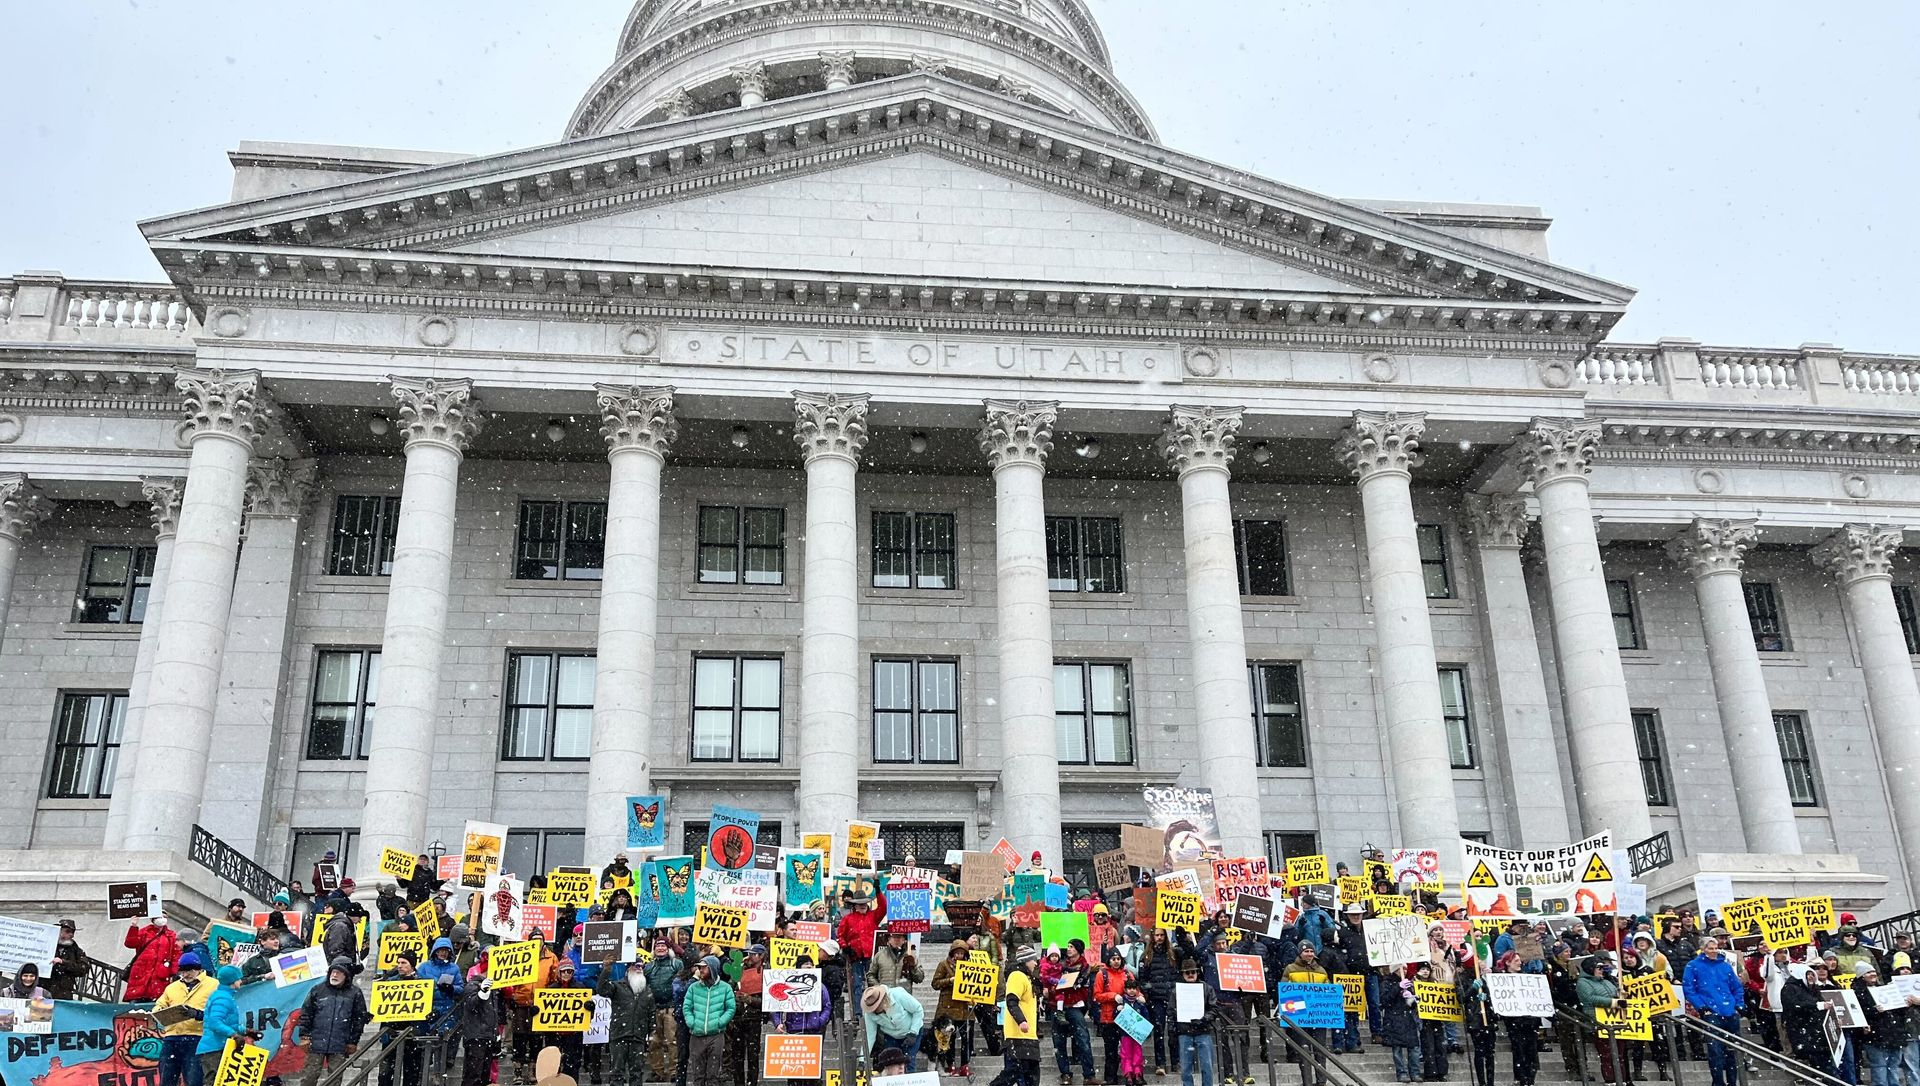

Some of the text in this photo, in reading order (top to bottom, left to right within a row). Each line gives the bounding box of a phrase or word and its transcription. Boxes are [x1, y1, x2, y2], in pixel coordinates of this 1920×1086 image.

[720, 336, 1126, 374] STATE OF UTAH
[714, 813, 758, 827] PEOPLE POWER
[386, 849, 414, 860] Protect
[1466, 836, 1609, 861] PROTECT OUR FUTURE
[388, 854, 411, 866] WILD
[466, 854, 497, 864] BREAK FREE
[384, 862, 410, 875] UTAH
[1097, 862, 1124, 873] FEDERAL
[1217, 861, 1266, 878] RISE UP
[1293, 863, 1321, 872] WILD
[1500, 858, 1576, 873] SAY NO TO
[727, 870, 742, 880] RISE
[919, 869, 935, 880] LET
[1099, 871, 1113, 880] KEEP
[1293, 871, 1323, 882] UTAH
[1504, 870, 1574, 886] URANIUM
[555, 882, 588, 891] WILD
[732, 887, 761, 896] KEEP
[552, 892, 588, 902] UTAH
[890, 891, 928, 902] PROTECT
[1160, 894, 1197, 904] Protect
[1342, 892, 1357, 900] UTAH
[1790, 898, 1828, 906] Protect
[416, 902, 432, 914] Protect
[700, 906, 747, 916] Protect
[1164, 900, 1194, 913] WILD
[1724, 899, 1764, 912] Protect
[419, 911, 432, 924] WILD
[1161, 912, 1194, 925] UTAH
[1730, 906, 1764, 920] WILD
[1762, 908, 1799, 920] Protect
[704, 914, 742, 927] WILD
[1732, 918, 1758, 931] UTA
[1767, 916, 1799, 930] WILD
[1805, 915, 1829, 926] TAH
[422, 922, 436, 938] UTAH
[699, 926, 742, 942] UTAH
[1770, 927, 1804, 943] UTAH
[388, 942, 422, 952] WILD
[492, 944, 535, 955] Protect
[384, 952, 423, 964] UTH
[497, 952, 531, 967] WILD
[493, 965, 532, 981] UTAH
[960, 964, 996, 973] Protect
[962, 971, 992, 985] WILD
[1520, 976, 1542, 988] LET
[377, 982, 429, 990] Protect
[958, 984, 991, 997] UTAH
[1281, 984, 1336, 994] COLORADANS
[1418, 984, 1456, 994] Protege
[382, 990, 423, 1002] WILD
[1421, 994, 1455, 1005] UTAH
[1494, 989, 1544, 999] COX TAKE
[543, 1000, 583, 1010] WILD
[1343, 996, 1362, 1005] TAH
[1649, 993, 1670, 1009] AH
[377, 1003, 424, 1015] UTAH
[1419, 1005, 1461, 1016] SILVESTRE
[1497, 1002, 1554, 1012] OUR ROCKS
[540, 1012, 584, 1024] UTAH
[1604, 1007, 1642, 1020] WILD
[8, 1029, 118, 1062] DEFEND
[222, 1049, 244, 1086] UTA
[237, 1056, 256, 1086] WIL
